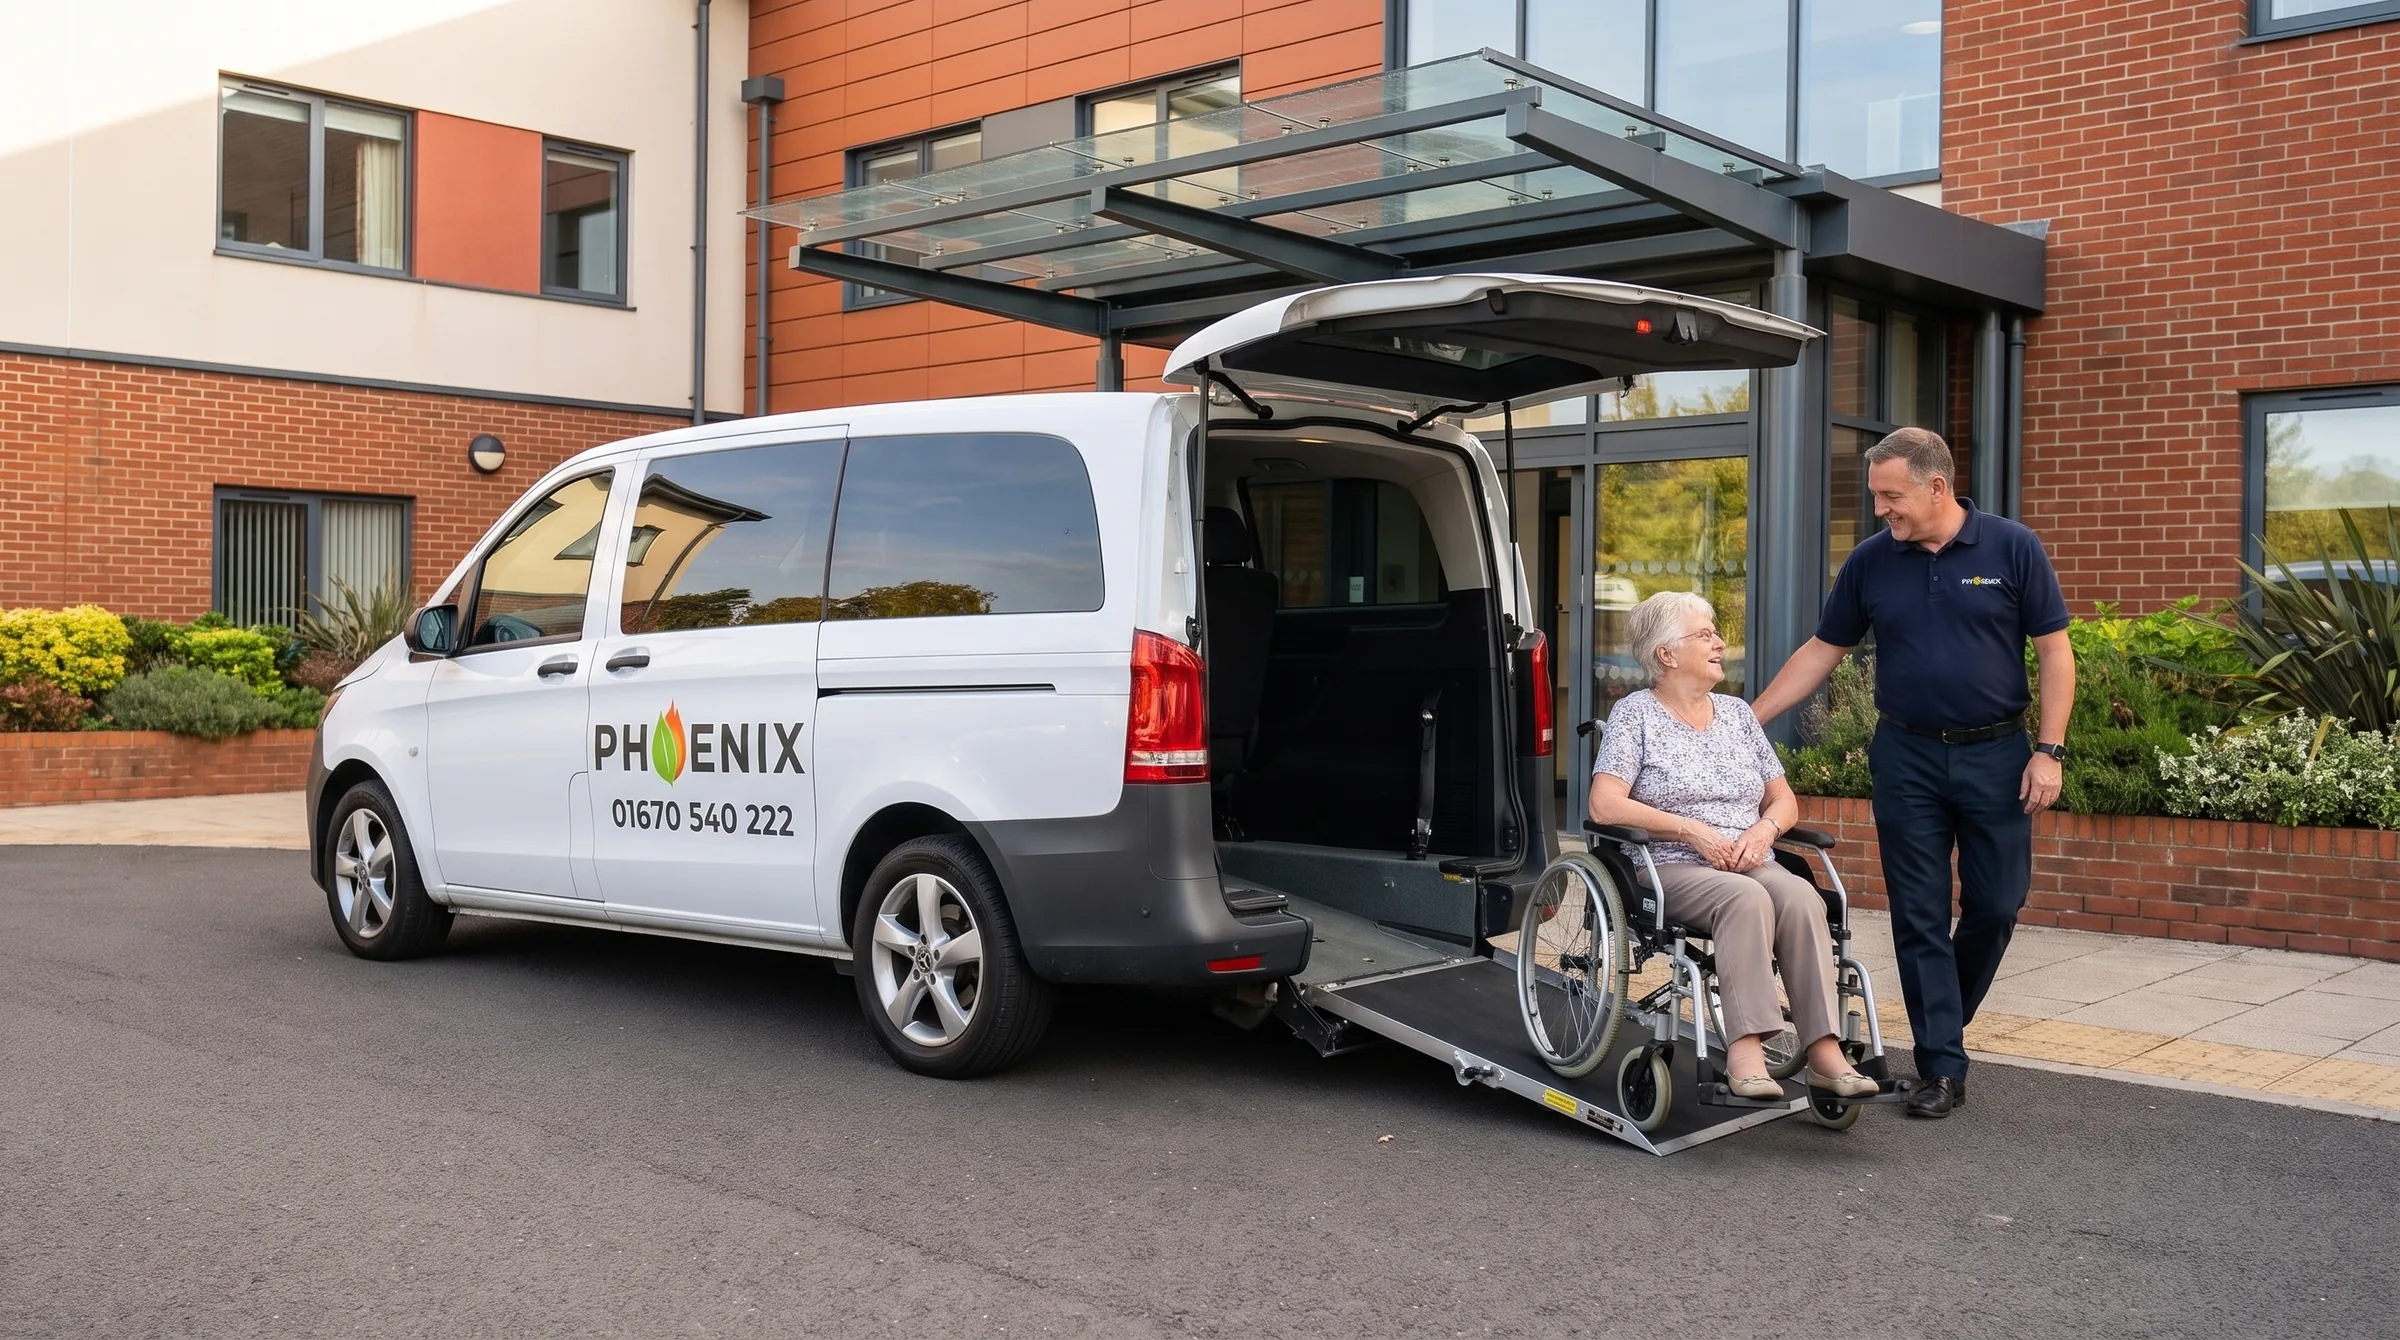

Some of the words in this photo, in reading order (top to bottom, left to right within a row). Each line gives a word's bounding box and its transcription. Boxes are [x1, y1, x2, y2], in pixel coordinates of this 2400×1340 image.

[612, 799, 681, 831] 01670
[689, 802, 738, 834] 540
[744, 804, 794, 836] 222
